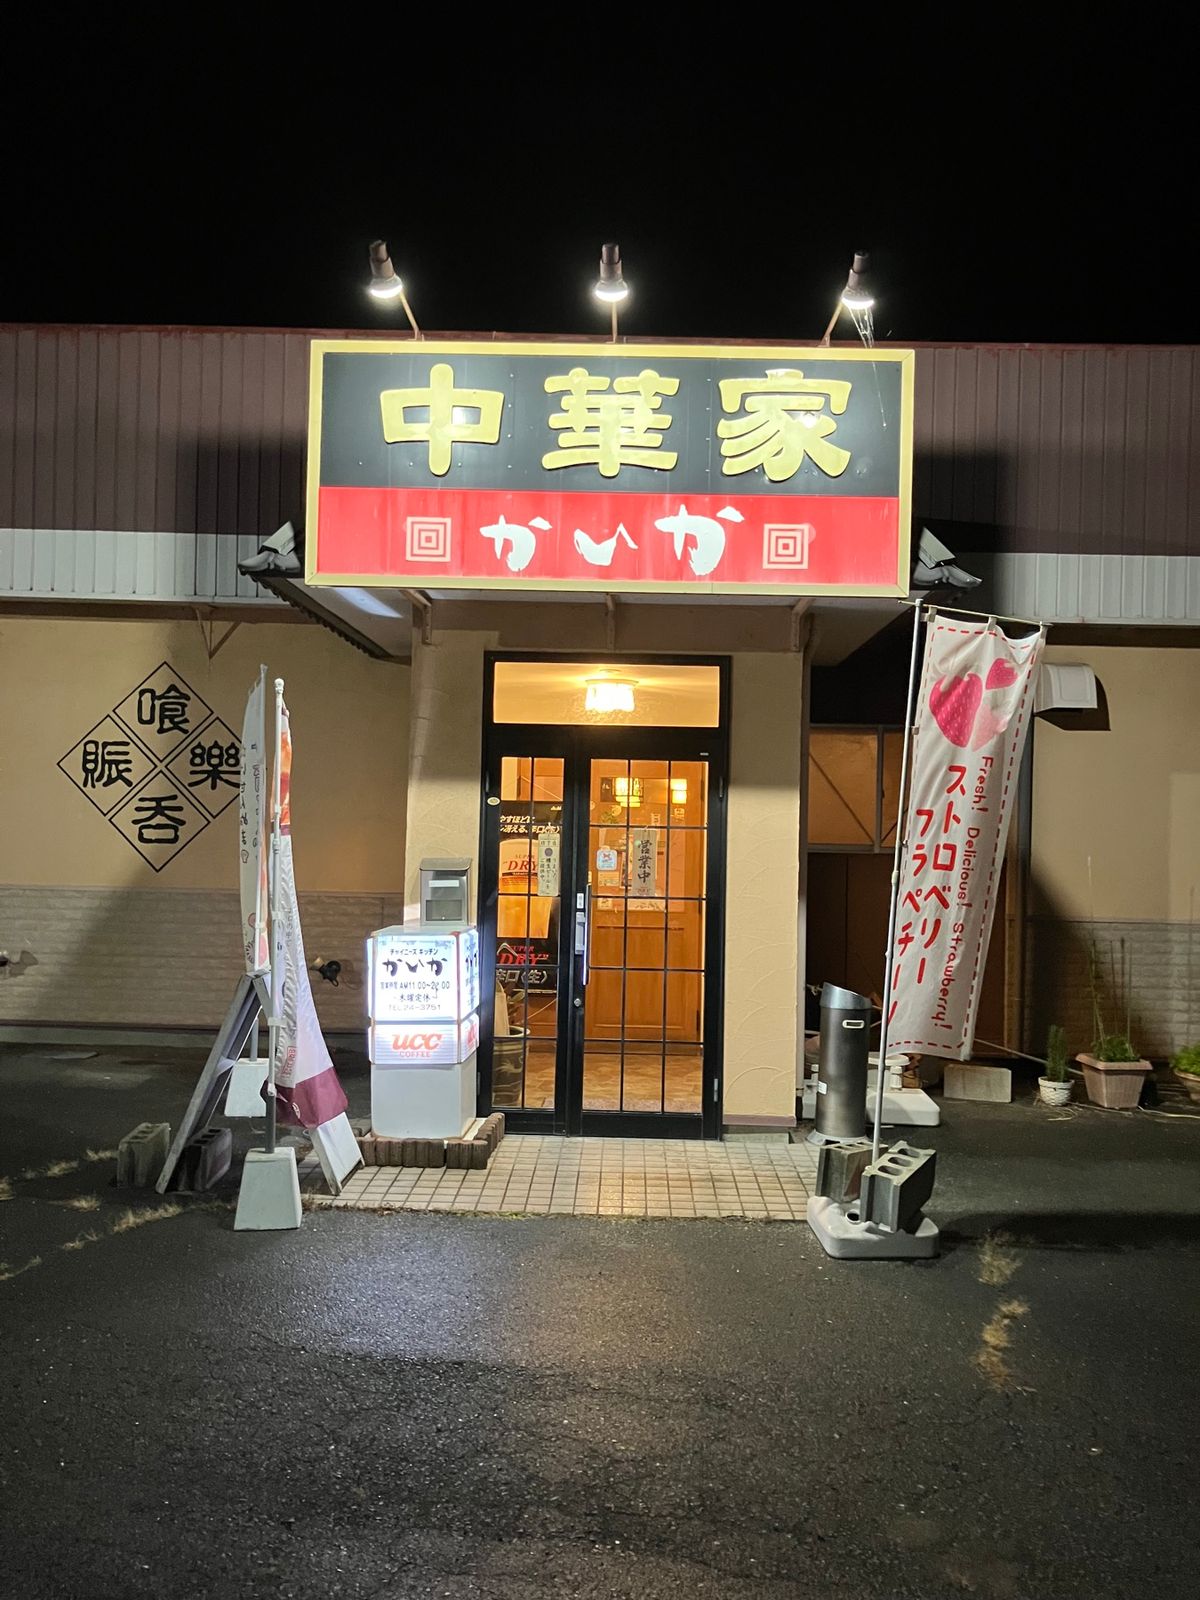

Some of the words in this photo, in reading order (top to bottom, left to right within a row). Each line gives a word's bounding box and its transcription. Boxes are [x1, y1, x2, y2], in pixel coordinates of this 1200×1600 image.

[380, 363, 853, 482] 中華家
[480, 504, 744, 576] かいか
[137, 684, 191, 734] 喰
[82, 740, 133, 788] 賑
[971, 756, 994, 813] Fresh!
[131, 795, 186, 844] 呑
[637, 840, 653, 883] 営業中
[917, 765, 967, 984] ストロベリー
[957, 827, 980, 909] Delicious!
[382, 957, 448, 977] かいか
[931, 923, 965, 1031] Strawberry!
[399, 1050, 431, 1058] COFFEE
